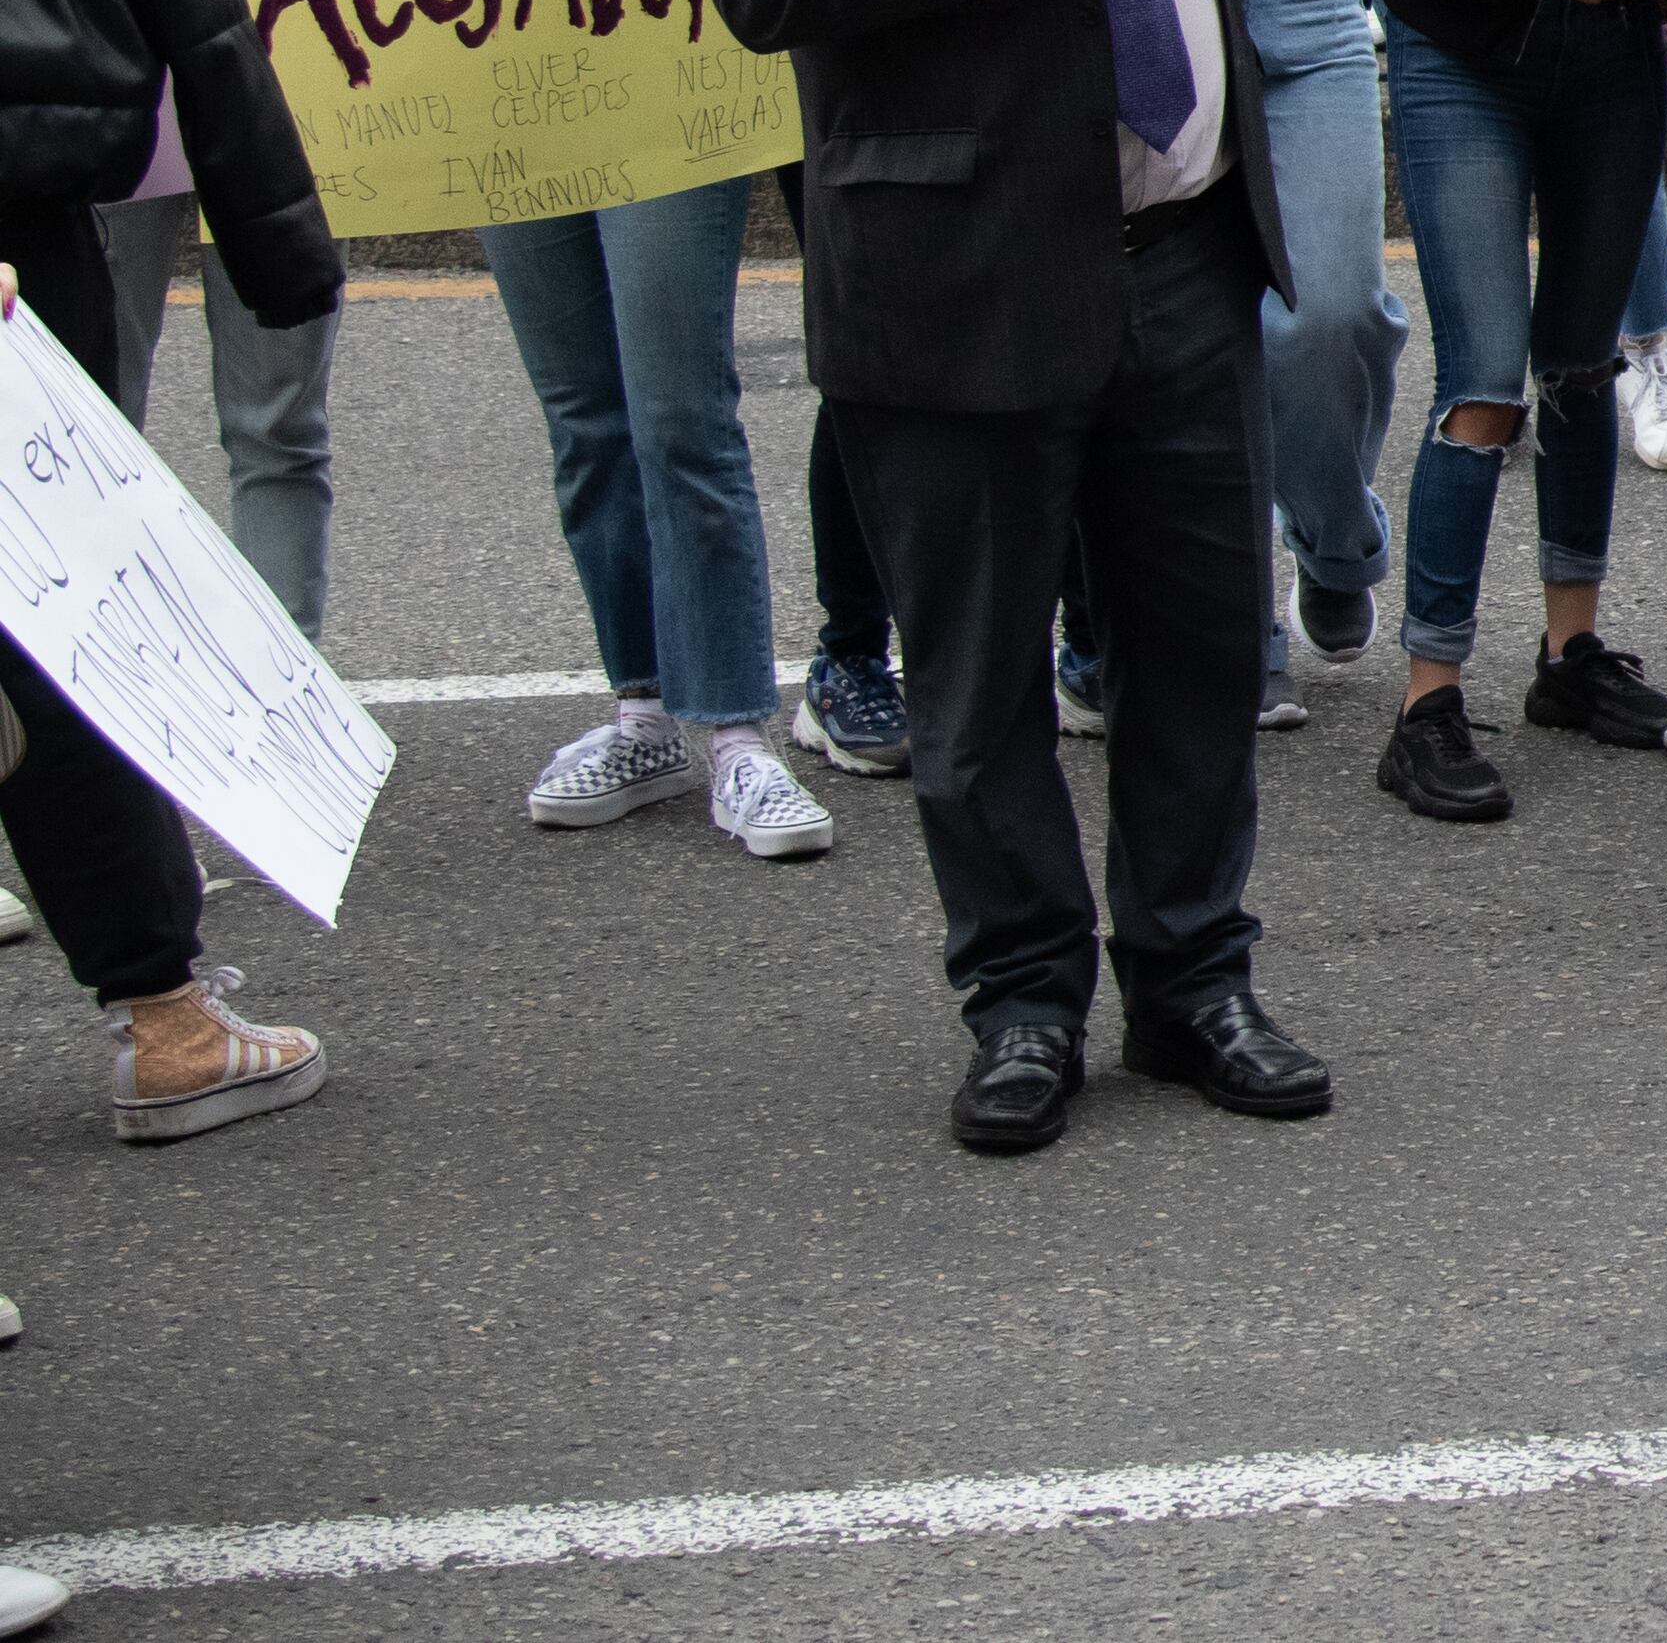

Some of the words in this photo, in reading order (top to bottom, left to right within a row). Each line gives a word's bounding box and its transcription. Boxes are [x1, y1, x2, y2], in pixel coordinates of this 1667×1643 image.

[492, 47, 598, 93] ELVER
[335, 94, 457, 152] MANUEL
[677, 86, 790, 151] VARGAS
[486, 159, 637, 224] BENAVIDES
